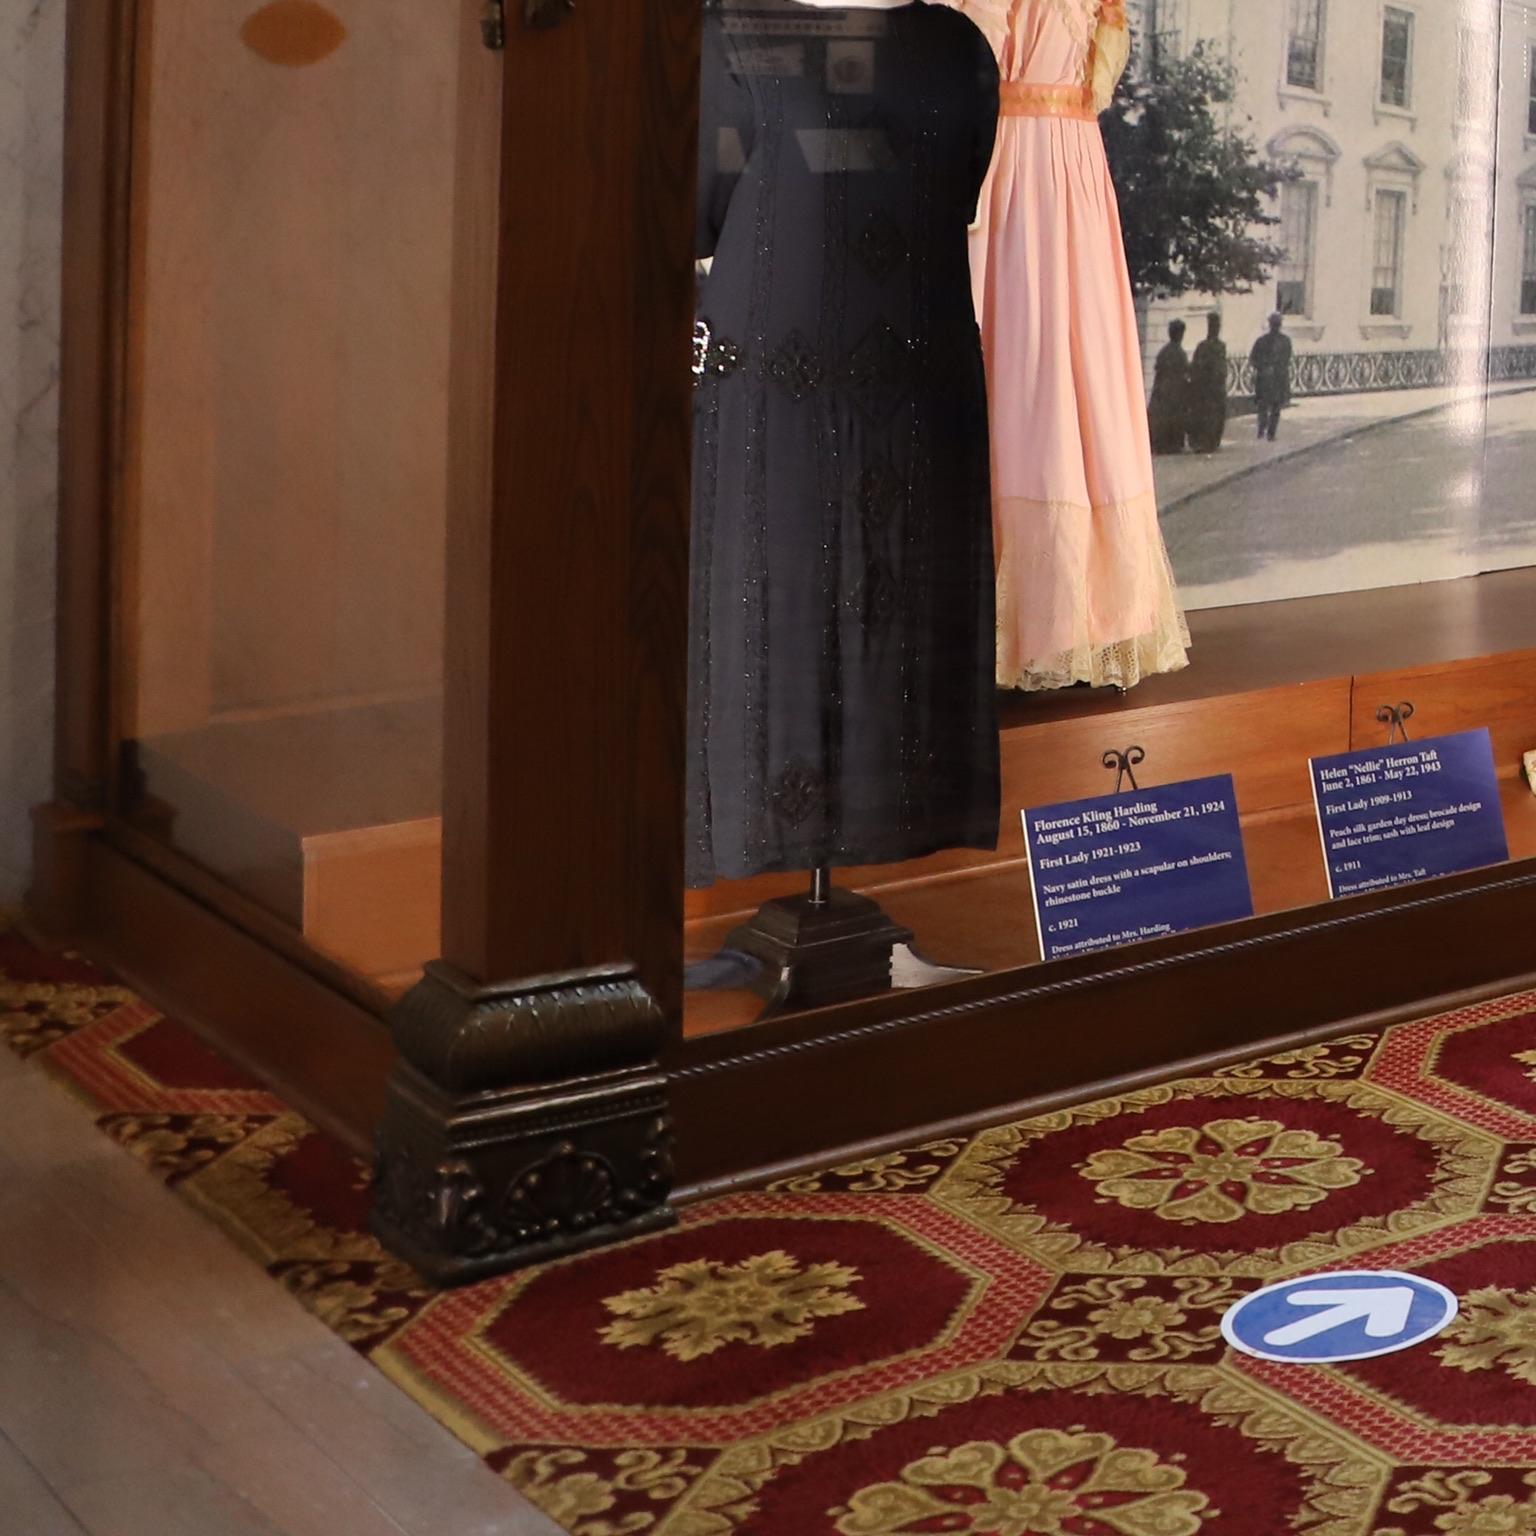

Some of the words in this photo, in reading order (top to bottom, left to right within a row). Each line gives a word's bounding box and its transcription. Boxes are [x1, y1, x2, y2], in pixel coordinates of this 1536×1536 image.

[1321, 767, 1348, 780] Helen
[1386, 755, 1418, 768] Herron
[1419, 749, 1437, 761] Taft
[1322, 780, 1343, 793] June
[1345, 778, 1354, 788] 2,
[1356, 774, 1376, 786] 1861
[1385, 769, 1403, 781] May
[1405, 766, 1419, 776] 22,
[1420, 761, 1441, 773] 1943
[1034, 817, 1080, 832] Florence
[1083, 811, 1112, 823] Kling
[1114, 802, 1157, 817] Harding
[1326, 803, 1346, 815] First
[1348, 797, 1368, 810] Lady
[1370, 790, 1412, 807] 1909-1913
[1037, 829, 1074, 844] August
[1077, 827, 1092, 837] 15,
[1096, 821, 1119, 833] 1860
[1129, 811, 1181, 827] November
[1184, 806, 1199, 817] 21,
[1201, 801, 1224, 814] 1924
[1329, 827, 1351, 838] Peach
[1353, 823, 1366, 833] silk
[1368, 818, 1392, 832] garden
[1394, 815, 1406, 826] day
[1429, 806, 1457, 818] brocade
[1458, 801, 1481, 813] design
[1332, 839, 1346, 849] and
[1347, 836, 1362, 846] lace
[1383, 828, 1399, 839] sash
[1400, 825, 1416, 835] with
[1417, 821, 1430, 833] leaf
[1431, 817, 1455, 830] design
[1040, 857, 1063, 869] First
[1065, 851, 1088, 865] Lady
[1092, 842, 1140, 858] 1921-1923
[1344, 860, 1360, 871] 1911
[1043, 882, 1065, 895] Navy
[1067, 878, 1088, 890] satin
[1090, 874, 1112, 886] dress
[1113, 869, 1133, 881] with
[1141, 861, 1175, 875] scapular
[1339, 885, 1357, 893] Dress
[1358, 875, 1389, 888] attributed
[1398, 872, 1411, 880] Mrs.
[1413, 868, 1426, 877] Taft
[1045, 891, 1090, 907] rhinestone
[1092, 884, 1121, 897] buckle
[1048, 924, 1056, 932] c.
[1059, 918, 1078, 930] 1921
[1052, 944, 1073, 954] Dress
[1075, 934, 1111, 949] attributed
[1122, 930, 1137, 939] Mrs.
[1140, 924, 1170, 935] Harding
